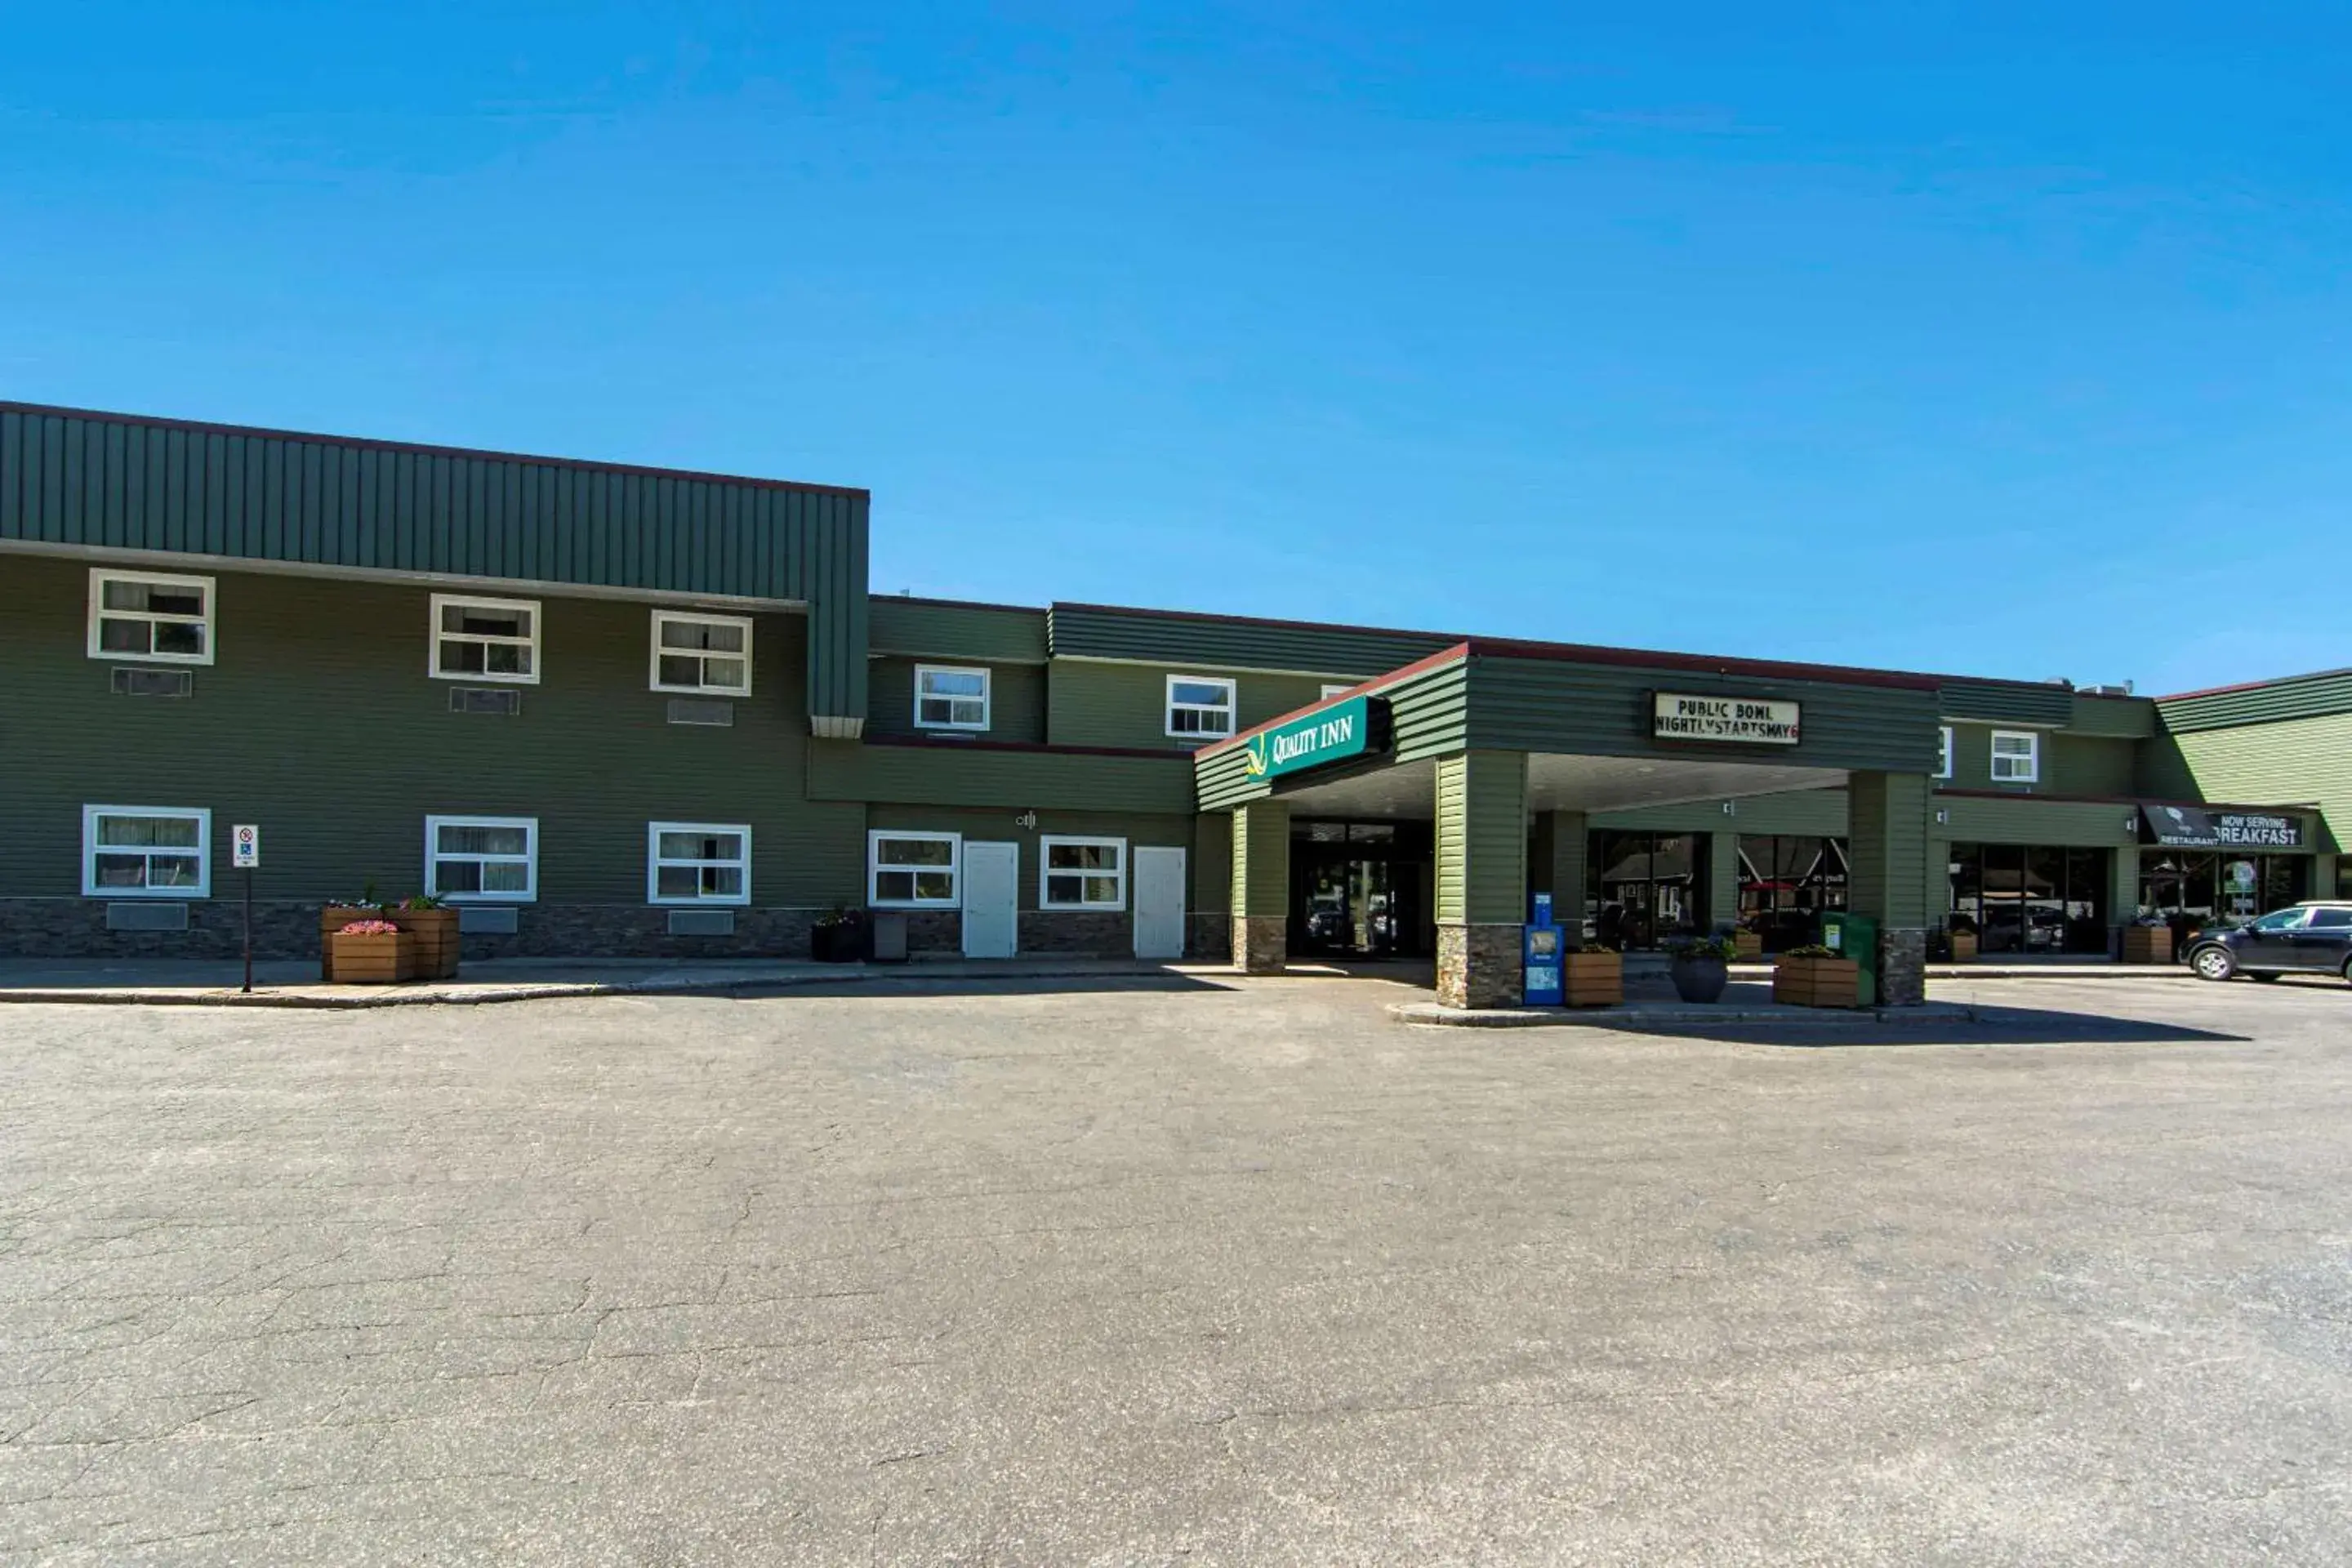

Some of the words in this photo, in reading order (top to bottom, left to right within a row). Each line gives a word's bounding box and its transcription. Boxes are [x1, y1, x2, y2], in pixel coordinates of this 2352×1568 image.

[1678, 700, 1728, 717] PUBLIC
[1272, 728, 1318, 764] QUALITY
[1321, 715, 1353, 748] INN
[2221, 815, 2244, 827] NOW
[2246, 817, 2287, 829] SERVING
[2161, 835, 2220, 845] RESTAURANT
